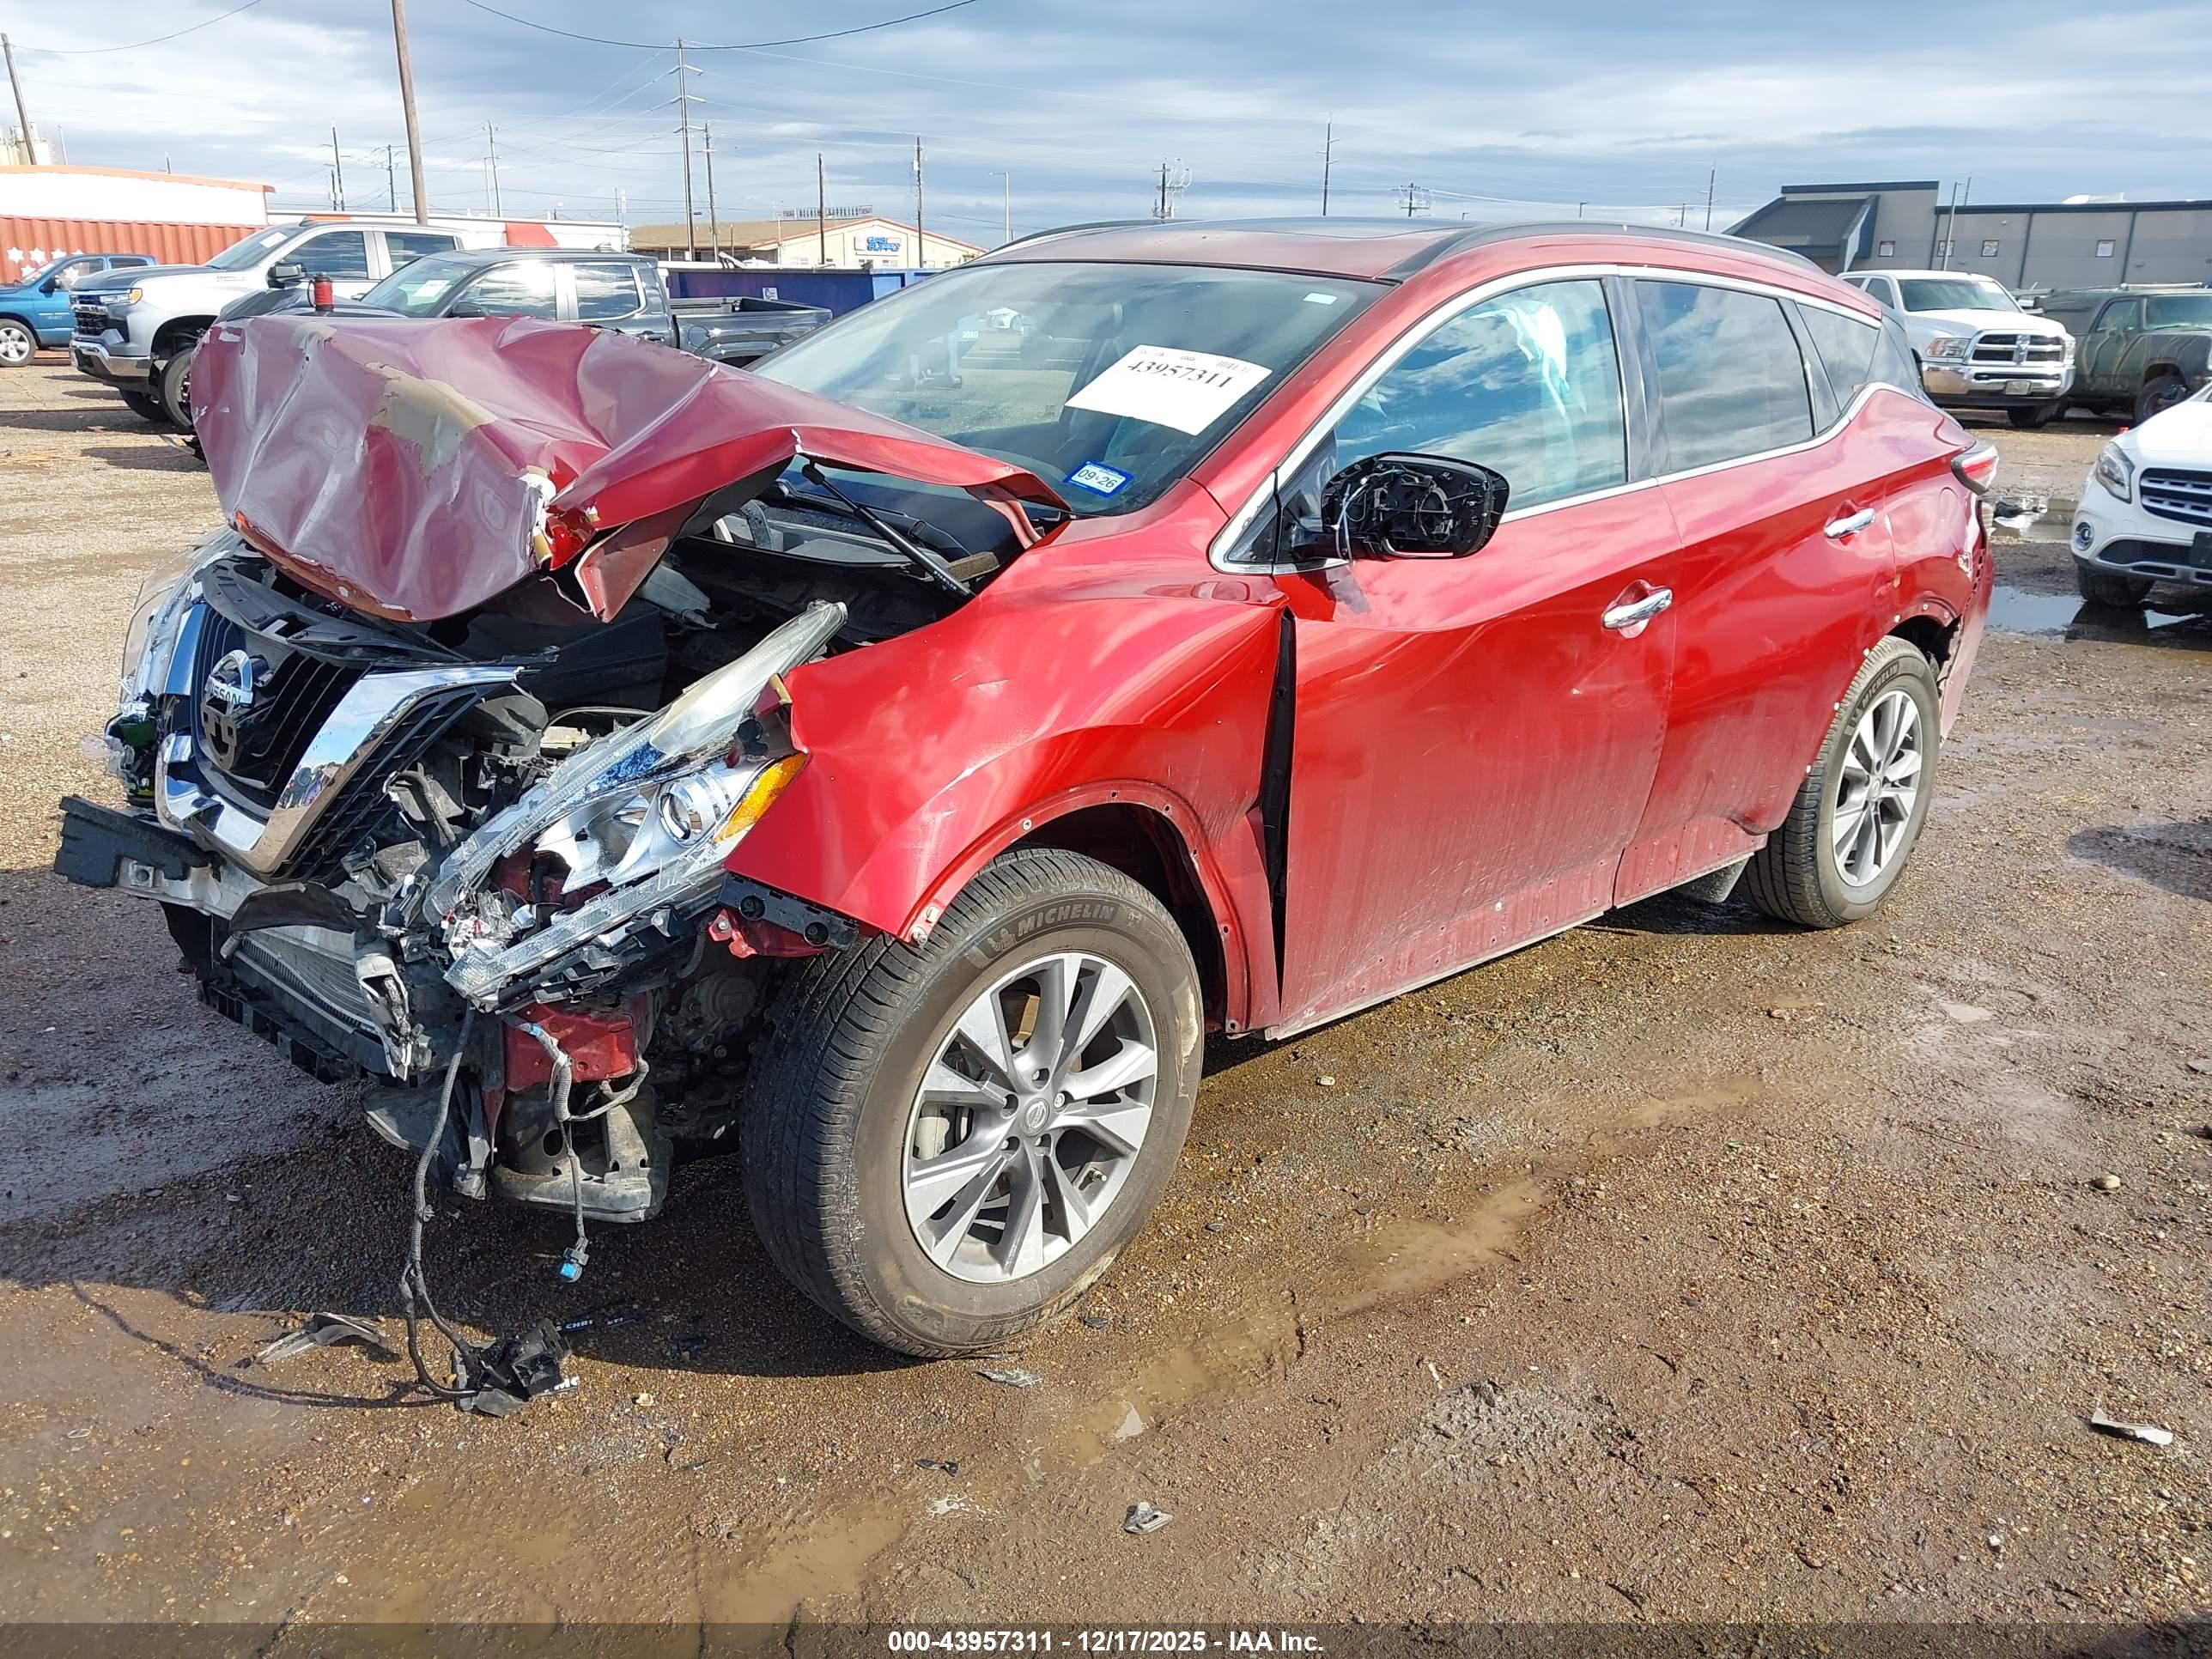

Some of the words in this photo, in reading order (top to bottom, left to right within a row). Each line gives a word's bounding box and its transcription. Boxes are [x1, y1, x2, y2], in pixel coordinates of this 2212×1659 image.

[1127, 361, 1233, 387] 43957311
[1862, 662, 1899, 708] MICHELIN
[1018, 904, 1115, 937] MICHELIN
